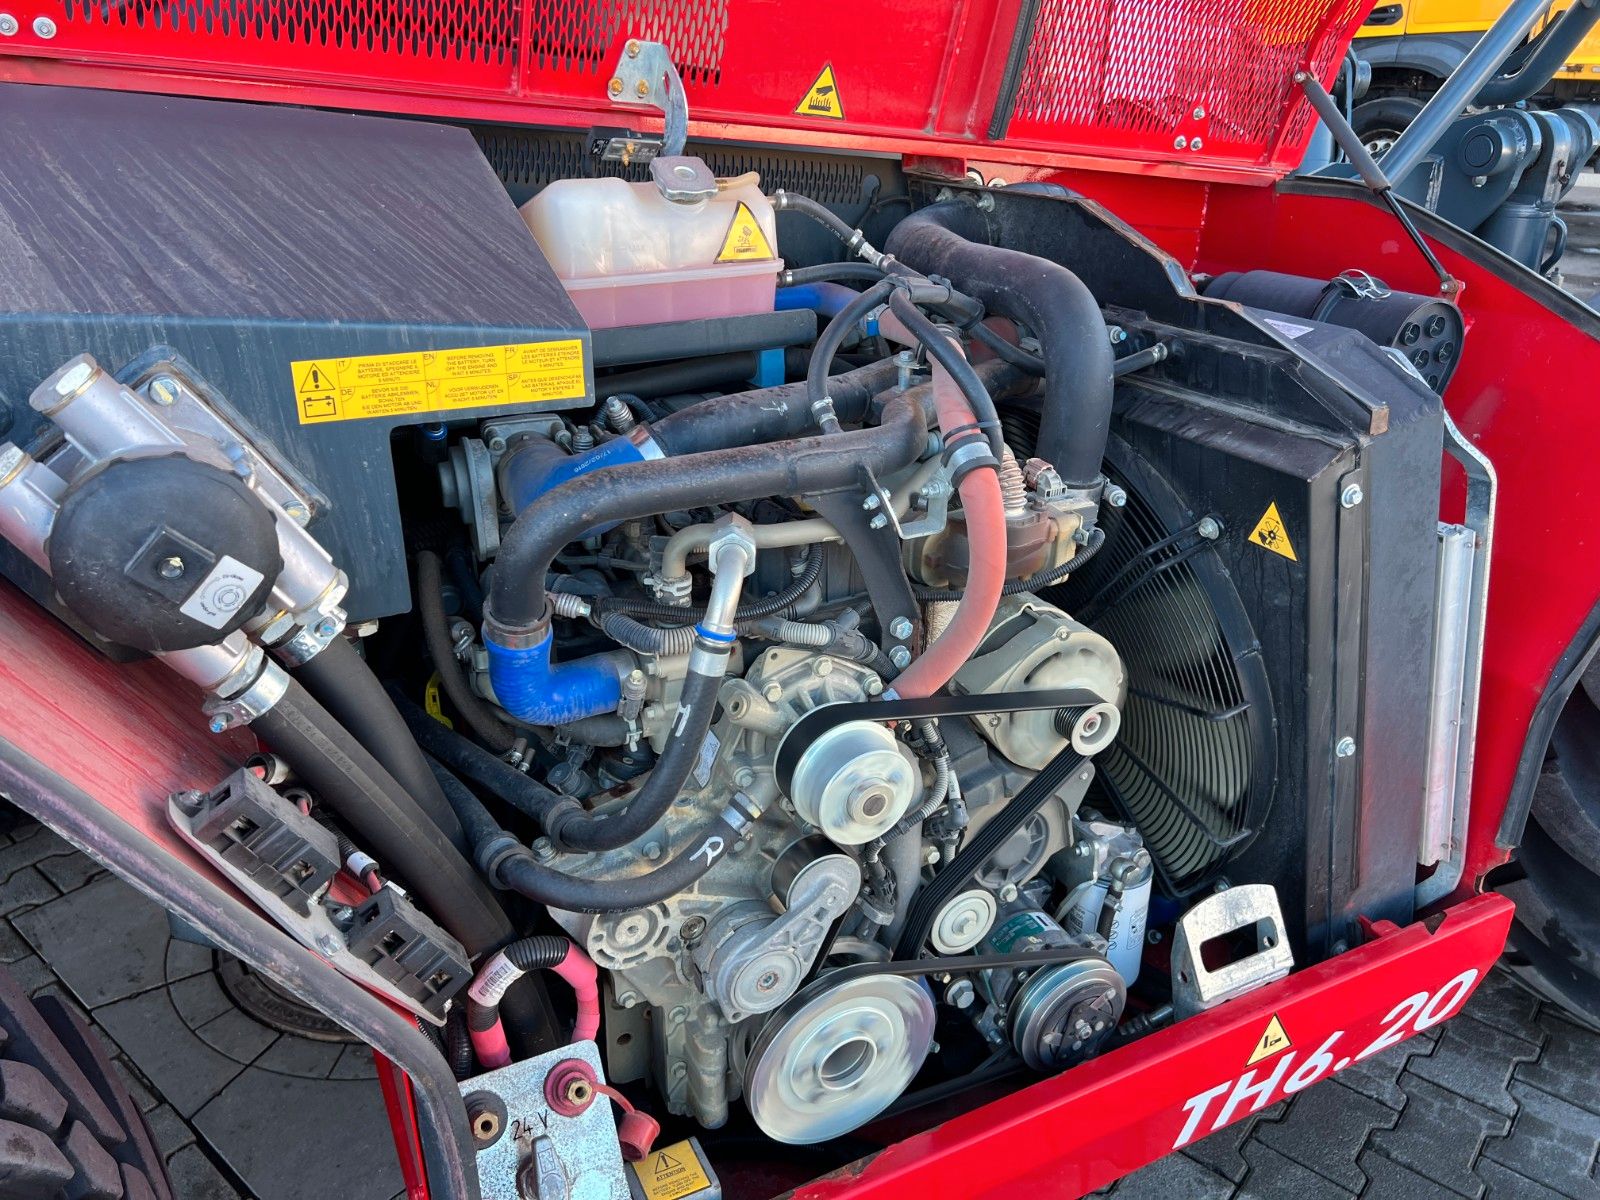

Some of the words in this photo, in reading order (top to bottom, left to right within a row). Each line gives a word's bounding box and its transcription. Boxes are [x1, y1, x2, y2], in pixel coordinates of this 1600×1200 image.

[423, 353, 435, 361] EN
[340, 388, 353, 396] DE
[689, 836, 725, 866] R
[1172, 968, 1479, 1150] TH6.20
[510, 1116, 533, 1141] 24
[537, 1108, 548, 1131] V
[656, 1167, 687, 1182] ATTENTION
